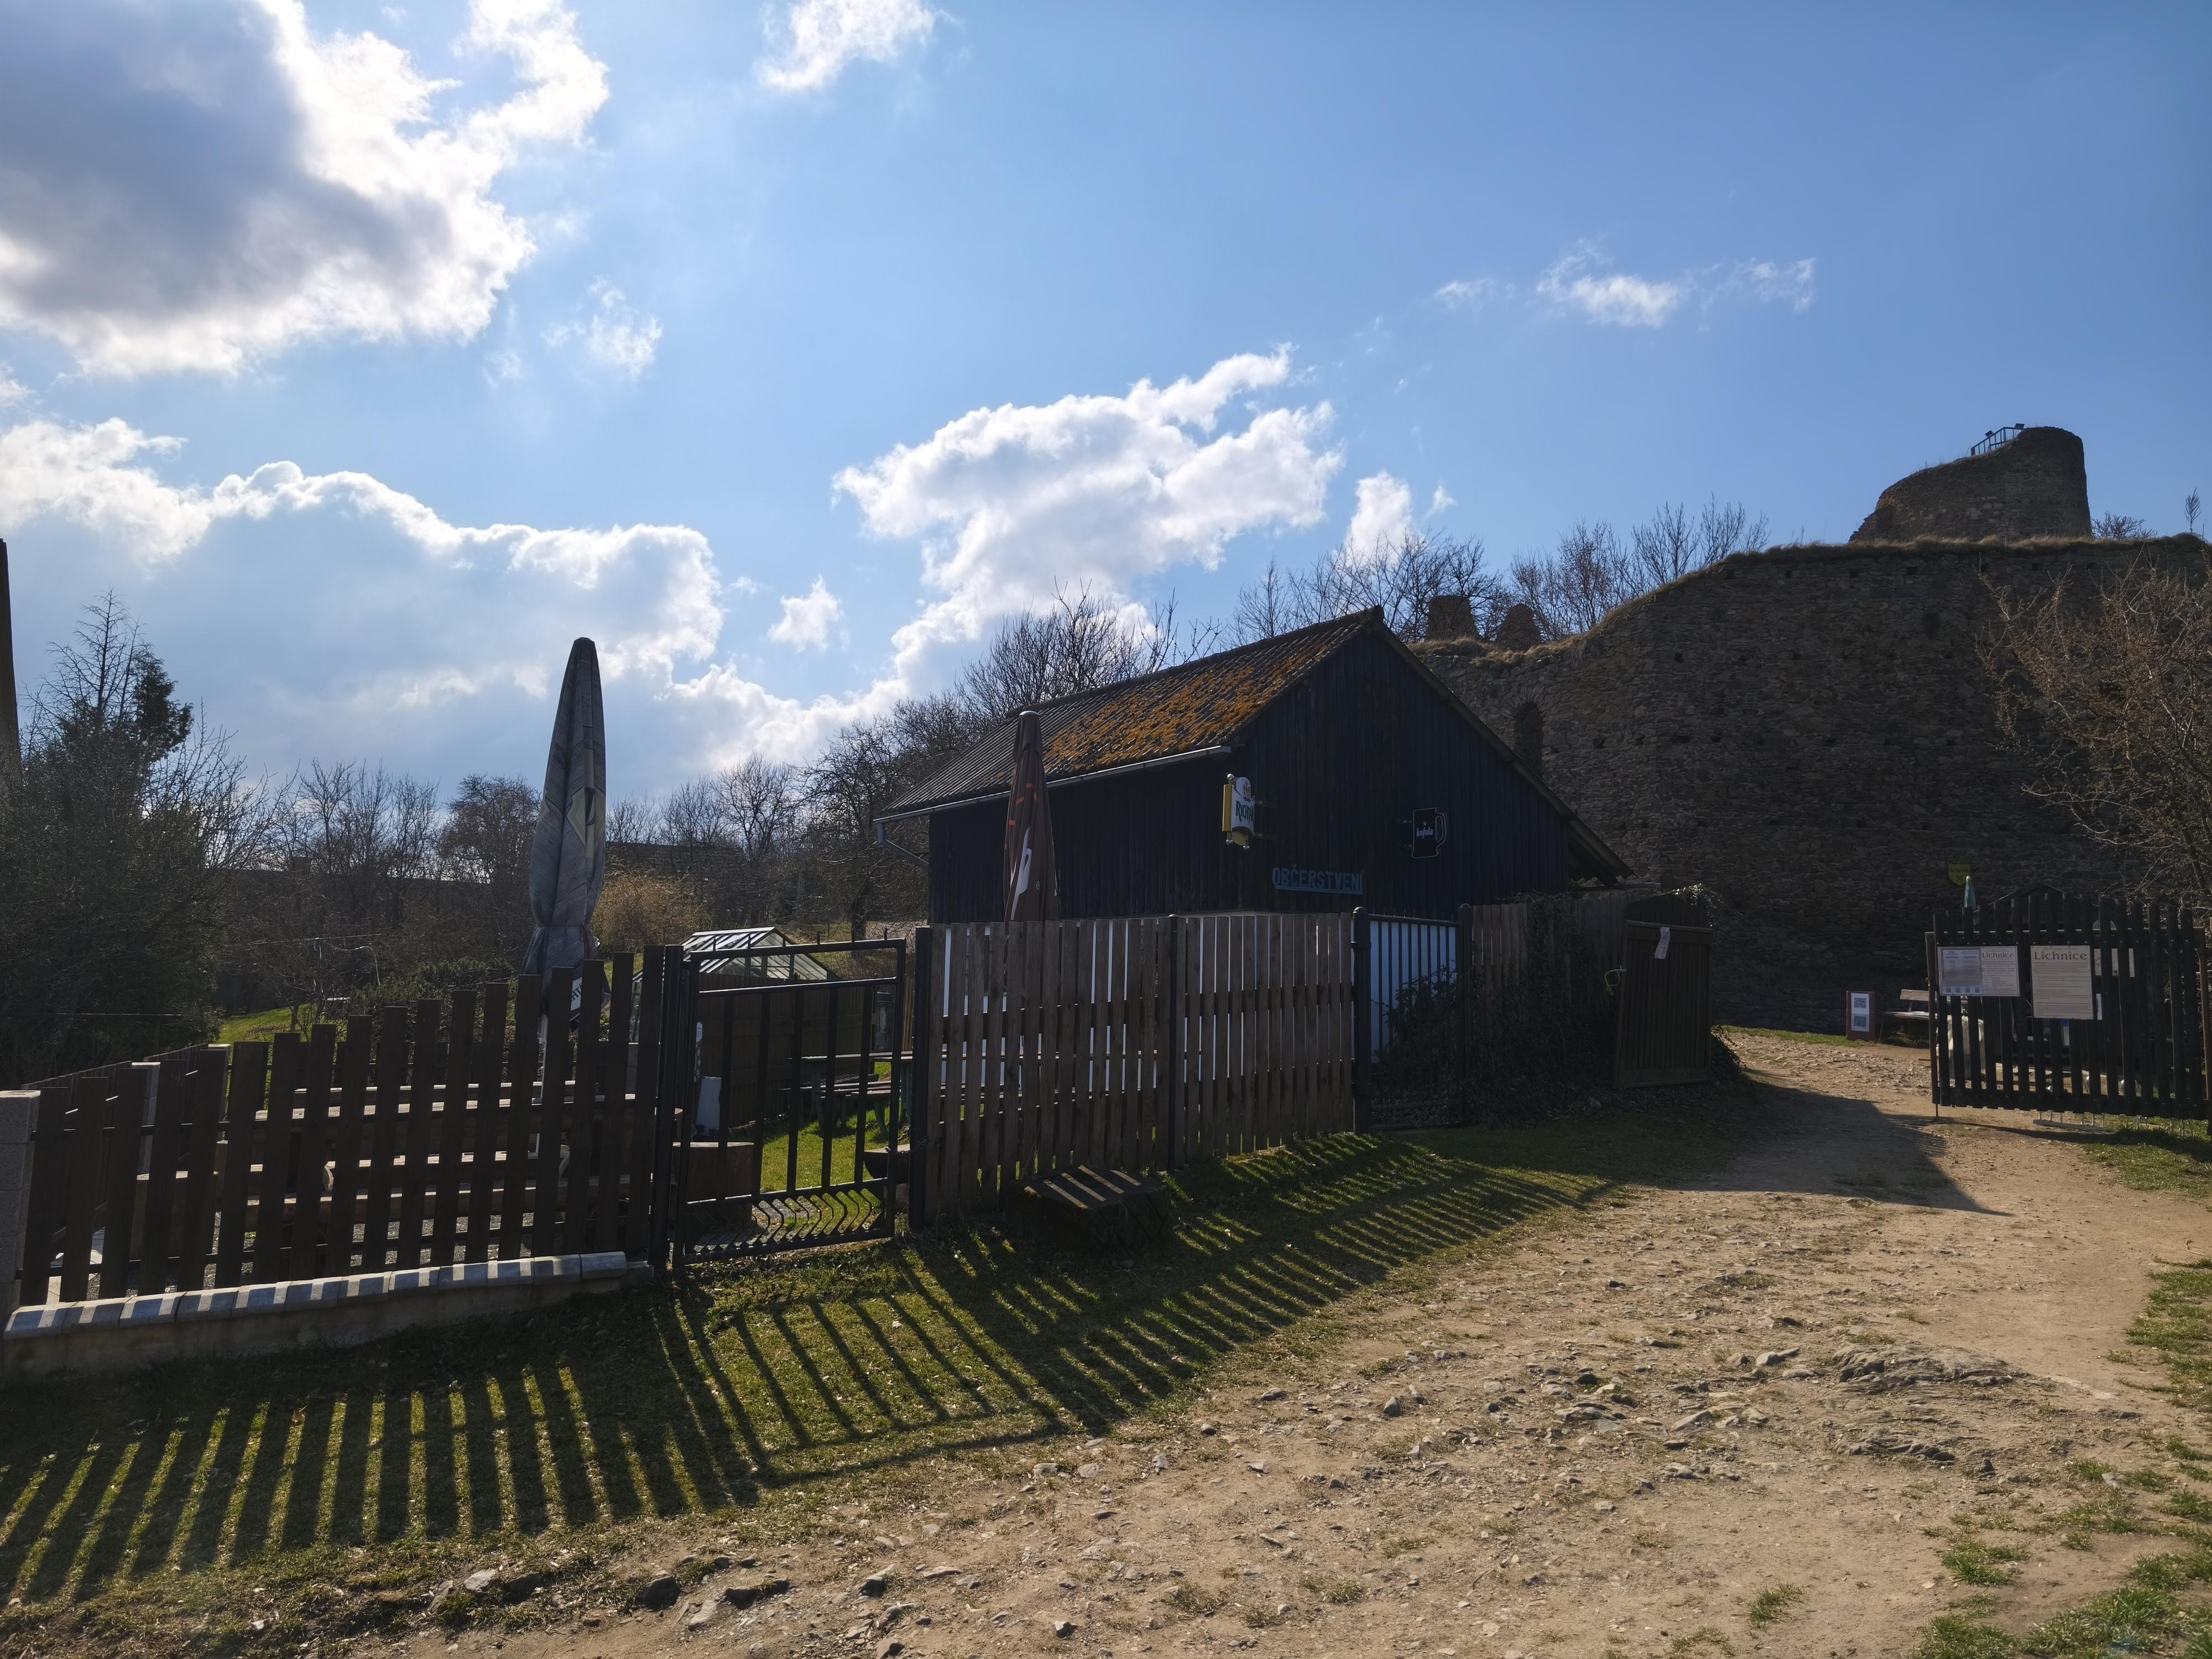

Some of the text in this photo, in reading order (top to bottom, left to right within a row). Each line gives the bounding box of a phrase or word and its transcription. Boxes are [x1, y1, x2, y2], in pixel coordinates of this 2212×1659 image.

[1416, 826, 1433, 839] kofola
[1272, 863, 1364, 891] OBČERSTVENÍ
[2034, 951, 2087, 960] Lichnice
